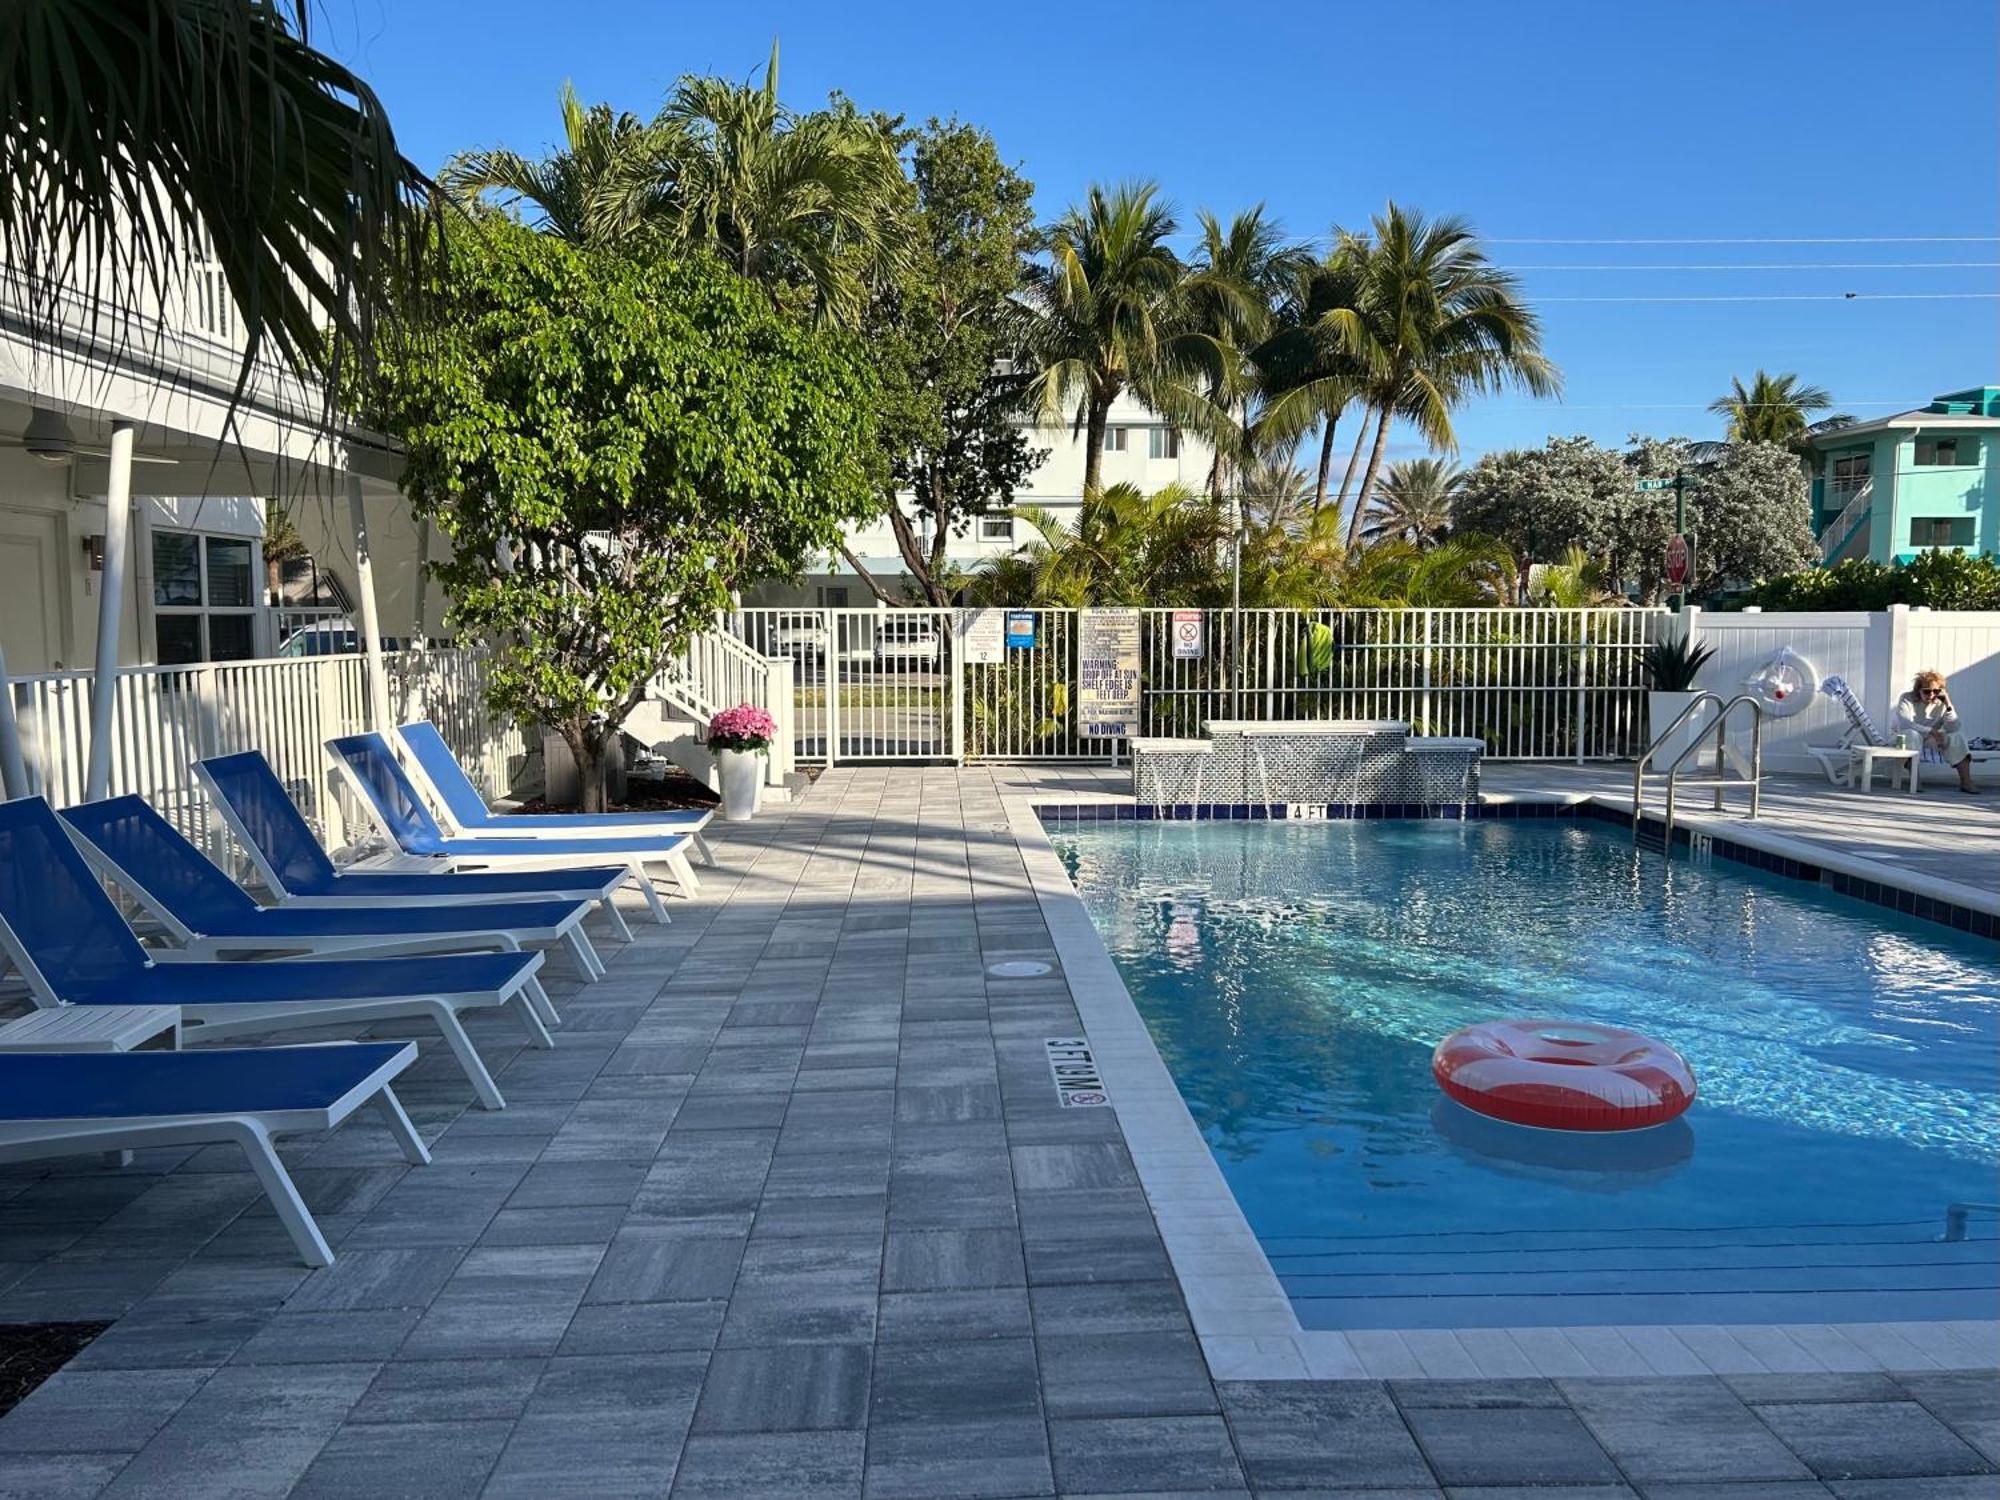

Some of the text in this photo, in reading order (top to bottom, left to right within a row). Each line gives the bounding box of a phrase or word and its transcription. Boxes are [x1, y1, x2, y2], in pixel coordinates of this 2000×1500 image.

[1668, 550, 1686, 568] STOP
[1082, 670, 1137, 679] DROP OFF AT SUN
[1082, 680, 1132, 689] SHELF EDGE IS
[1097, 690, 1110, 700] FEET
[1089, 724, 1126, 735] NO DIVING
[1294, 805, 1325, 818] 4 FT
